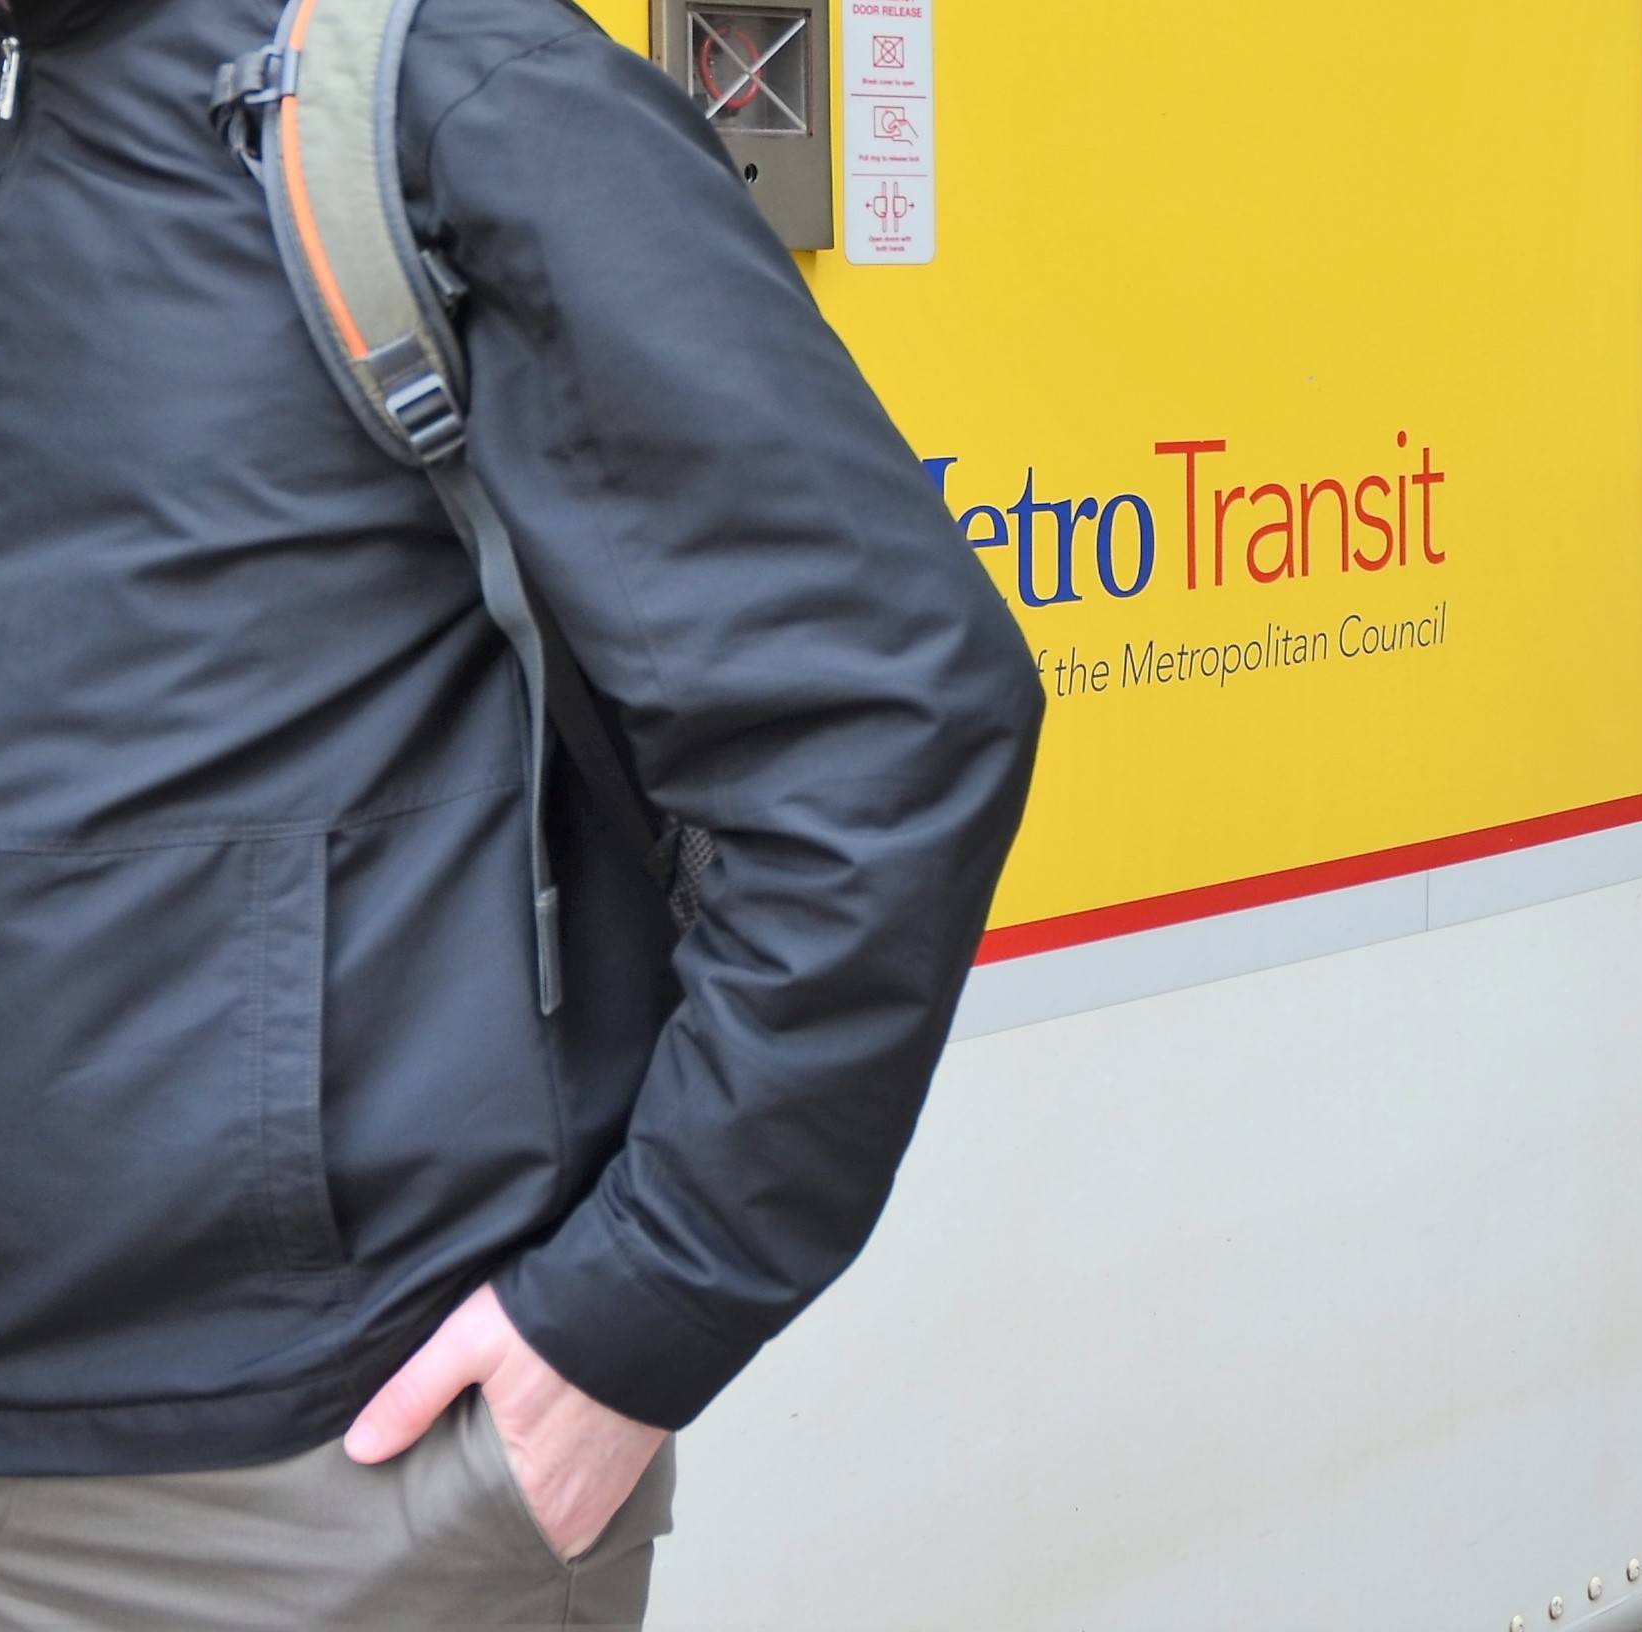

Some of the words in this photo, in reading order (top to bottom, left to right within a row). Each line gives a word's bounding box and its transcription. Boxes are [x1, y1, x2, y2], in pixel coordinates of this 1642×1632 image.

[852, 4, 879, 15] DOOR
[882, 6, 922, 18] RELEASE
[1154, 430, 1446, 590] Transit
[1055, 647, 1110, 697] the
[1122, 624, 1328, 688] Metropolitan
[1338, 601, 1447, 658] Council
